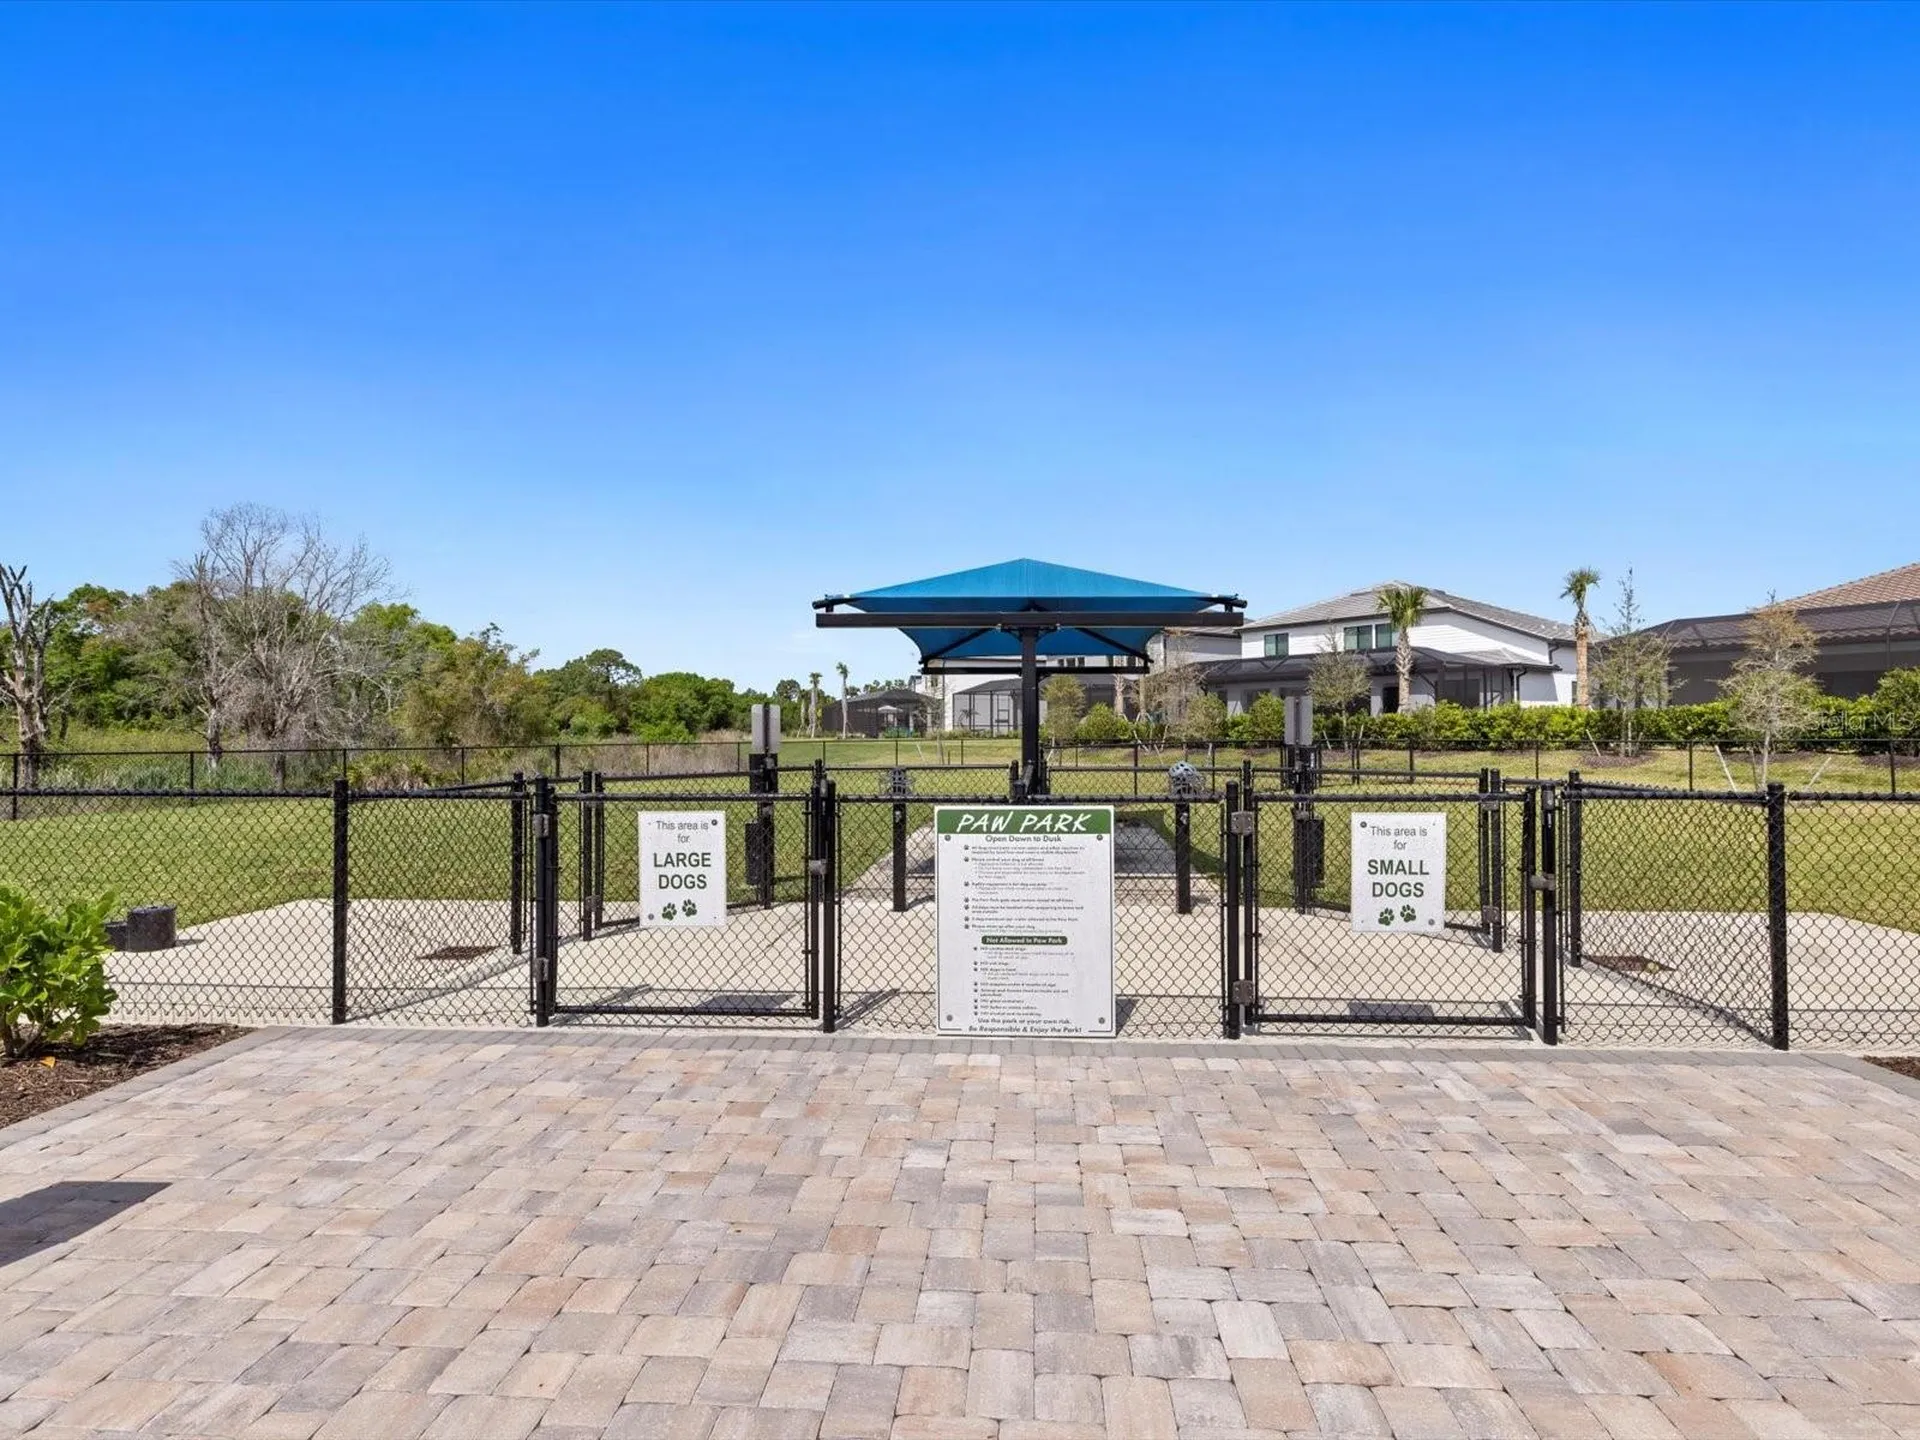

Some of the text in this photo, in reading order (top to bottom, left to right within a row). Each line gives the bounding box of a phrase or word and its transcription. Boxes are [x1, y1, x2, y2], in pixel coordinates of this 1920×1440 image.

[656, 821, 709, 830] This area is
[956, 811, 1092, 833] PAW PARK
[1371, 826, 1428, 837] This area is
[677, 833, 690, 844] for
[985, 834, 1007, 843] Open
[1393, 840, 1407, 850] for
[653, 852, 712, 868] LARGE
[1367, 859, 1430, 876] SMALL
[658, 874, 707, 890] DOGS
[1372, 882, 1425, 898] DOGS
